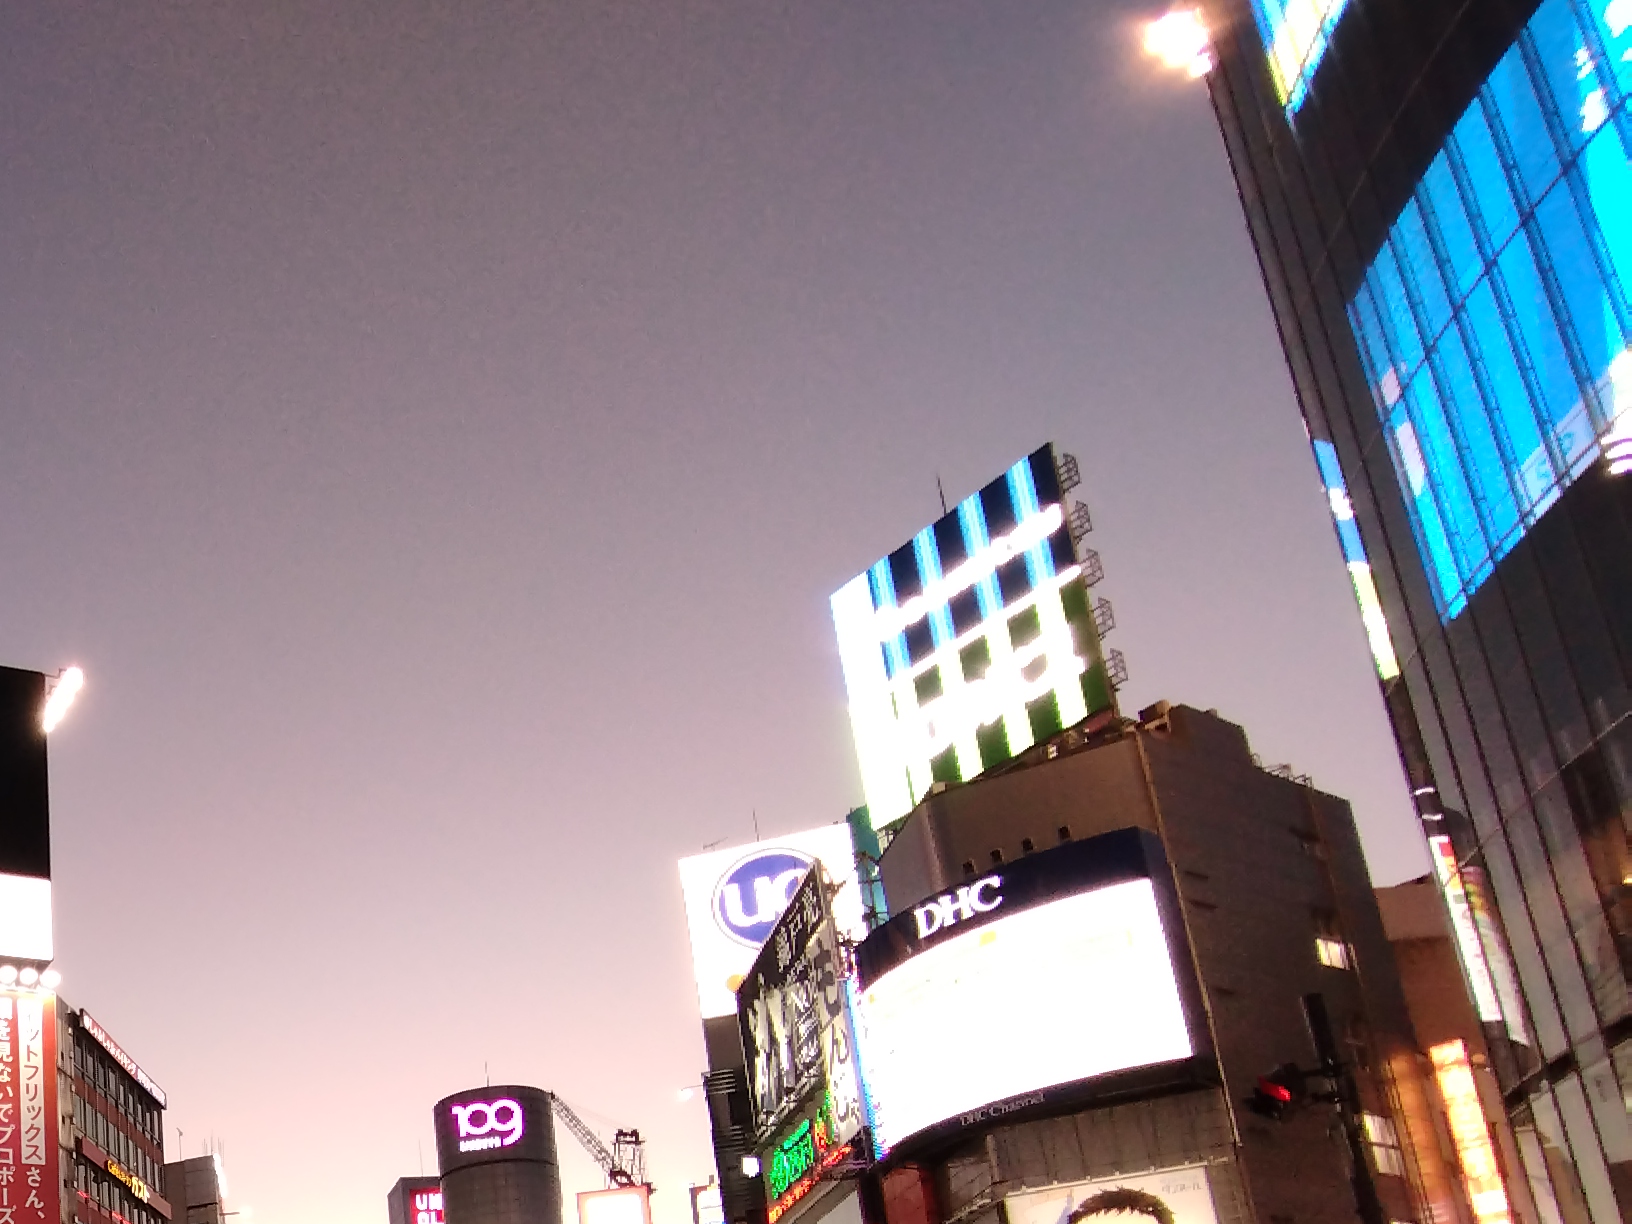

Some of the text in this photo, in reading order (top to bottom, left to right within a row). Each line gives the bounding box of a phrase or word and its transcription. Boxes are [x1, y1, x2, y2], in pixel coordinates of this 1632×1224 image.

[724, 868, 806, 928] UC
[915, 874, 1003, 939] DHC
[23, 1006, 46, 1219] ットフリックスさん、
[451, 1098, 523, 1146] 109
[416, 1193, 443, 1211] UN
